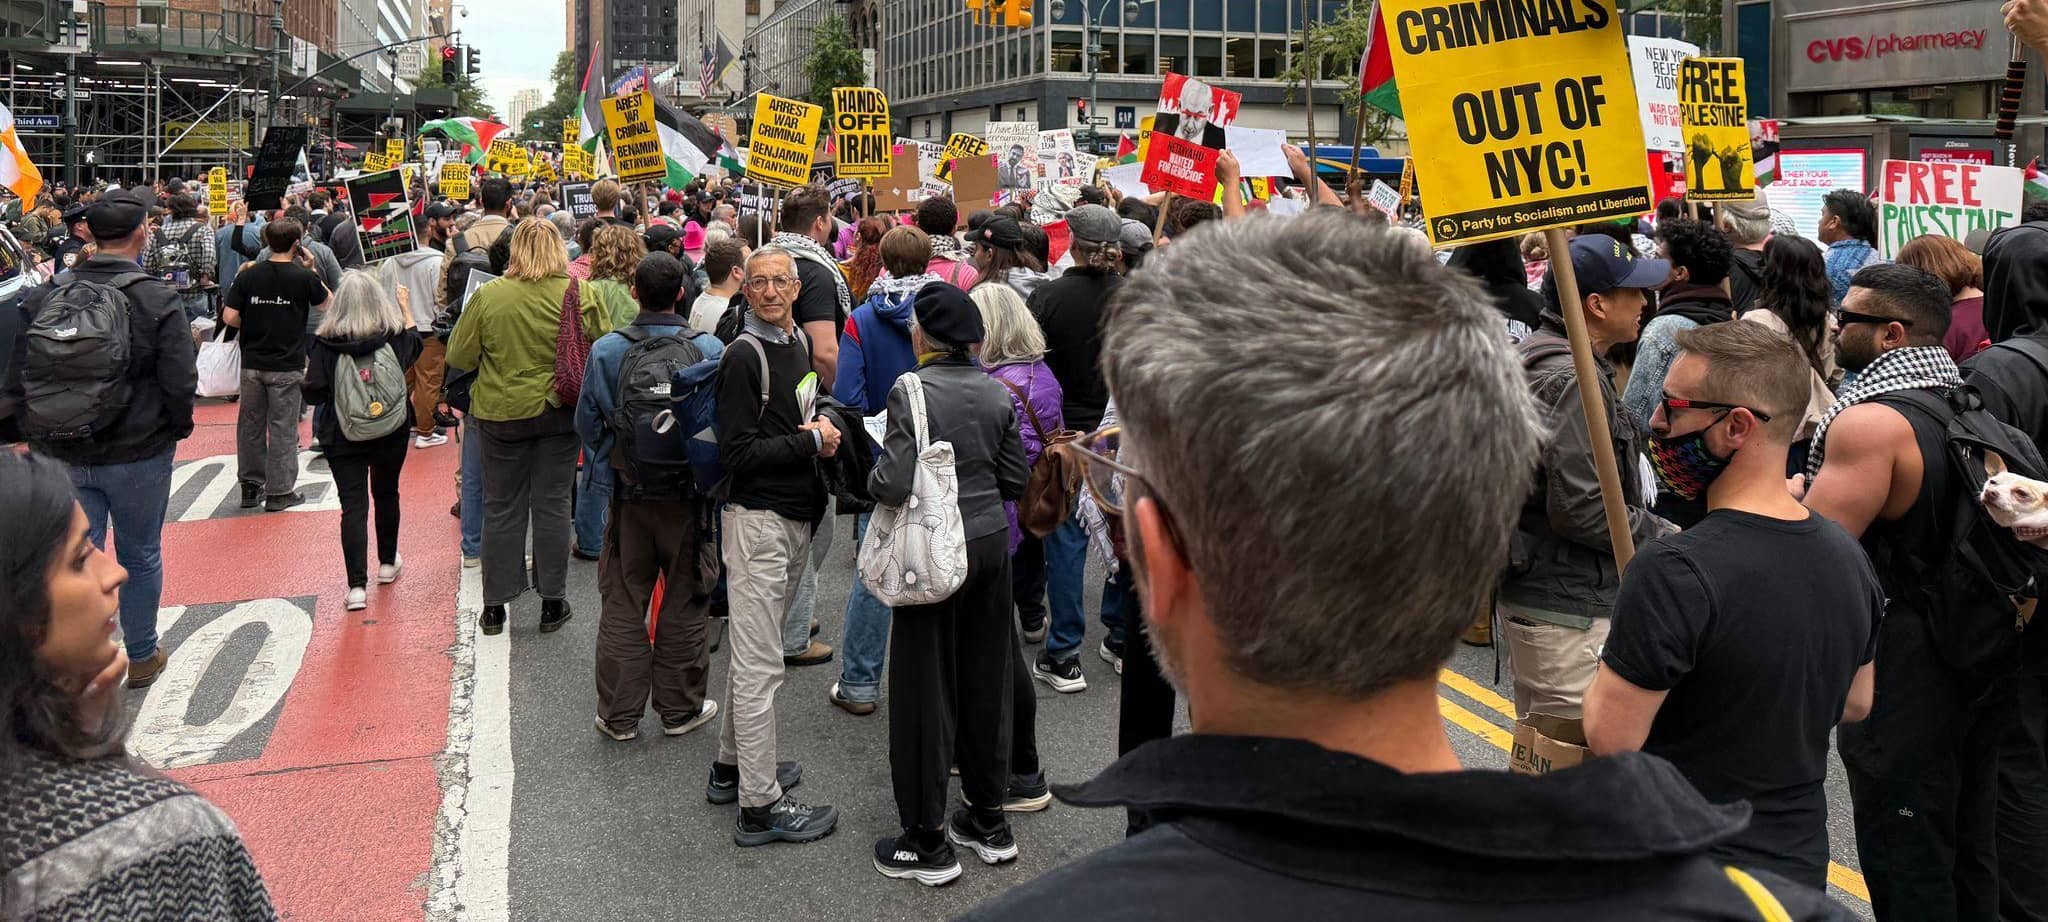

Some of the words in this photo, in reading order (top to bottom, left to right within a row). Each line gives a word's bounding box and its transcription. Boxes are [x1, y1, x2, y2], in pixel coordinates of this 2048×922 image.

[1397, 0, 1609, 55] CRIMINALS
[1646, 47, 1669, 62] NEW
[1807, 29, 1988, 63] CVS/pharmacy
[1681, 59, 1740, 104] FREE
[768, 98, 809, 118] ARREST
[838, 90, 885, 113] HANDS
[1452, 82, 1542, 145] OUT
[1555, 75, 1606, 131] OF
[1648, 102, 1667, 114] WAR
[36, 118, 52, 126] Ave
[774, 114, 799, 130] WAR
[838, 113, 886, 130] OFF
[1119, 112, 1132, 122] GAP
[1653, 114, 1668, 126] NOT
[1679, 104, 1745, 127] PALESTINE
[758, 123, 807, 145] CRIMINAL
[491, 140, 513, 153] FREE
[752, 141, 809, 165] BENJAMIN
[839, 134, 889, 163] IRAN!
[951, 134, 987, 155] FREE
[369, 154, 389, 166] FREE
[750, 155, 806, 178] NETANYAHU!
[1158, 160, 1171, 173] FOR
[1484, 139, 1591, 199] NYC!
[441, 170, 468, 181] NEEDS
[1884, 161, 1982, 207] FREE
[742, 194, 757, 207] WHY
[1461, 217, 1495, 232] Party
[1496, 213, 1512, 227] for
[1514, 206, 1574, 224] Socialism
[1576, 201, 1598, 214] and
[1599, 195, 1647, 211] Liberation
[1899, 807, 1913, 817] alo
[893, 850, 919, 861] HOKA
